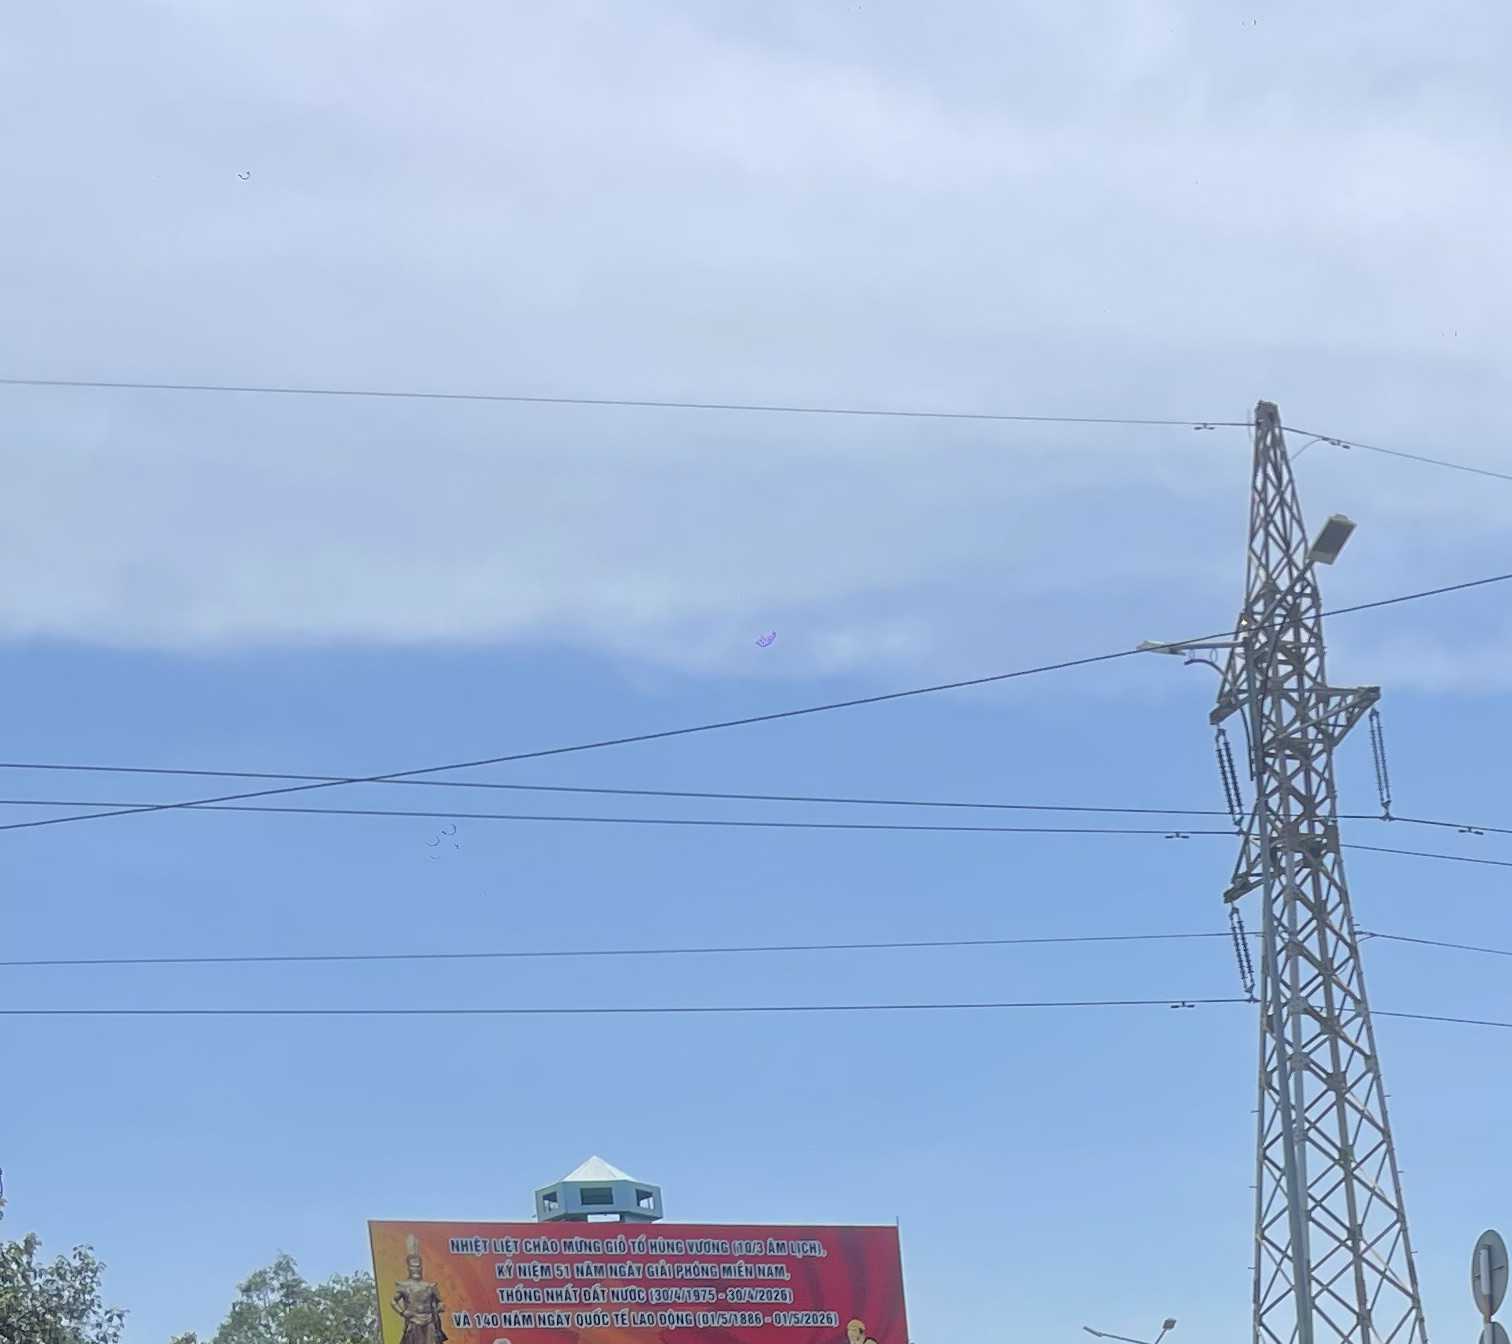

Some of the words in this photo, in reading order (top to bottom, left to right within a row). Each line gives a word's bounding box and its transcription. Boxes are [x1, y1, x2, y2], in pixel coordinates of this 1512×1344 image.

[449, 1236, 489, 1256] NHIỆT
[492, 1236, 520, 1256] LIỆT
[523, 1236, 560, 1255] CHÀO
[562, 1236, 601, 1255] MỪNG
[649, 1237, 685, 1256] HÙNG
[686, 1238, 729, 1256] VƯƠNG
[517, 1261, 552, 1281] NIỆM
[554, 1262, 571, 1279] 51
[574, 1261, 606, 1280] NĂM
[608, 1260, 644, 1280] NGÀY
[646, 1259, 673, 1279] GIẢI
[674, 1261, 719, 1280] PHÓNG
[498, 1283, 542, 1303] THỐNG
[544, 1283, 579, 1303] NHẤT
[581, 1283, 608, 1303] ĐẤT
[610, 1285, 647, 1303] NƯỚC
[452, 1310, 472, 1329] VÀ
[474, 1313, 500, 1329] 140
[502, 1310, 535, 1329] NĂM
[536, 1310, 571, 1329] NGÀY
[575, 1308, 610, 1329] QUỐC
[612, 1308, 630, 1328] TẾ
[631, 1311, 655, 1327] LAO
[657, 1309, 693, 1329] ĐỘNG
